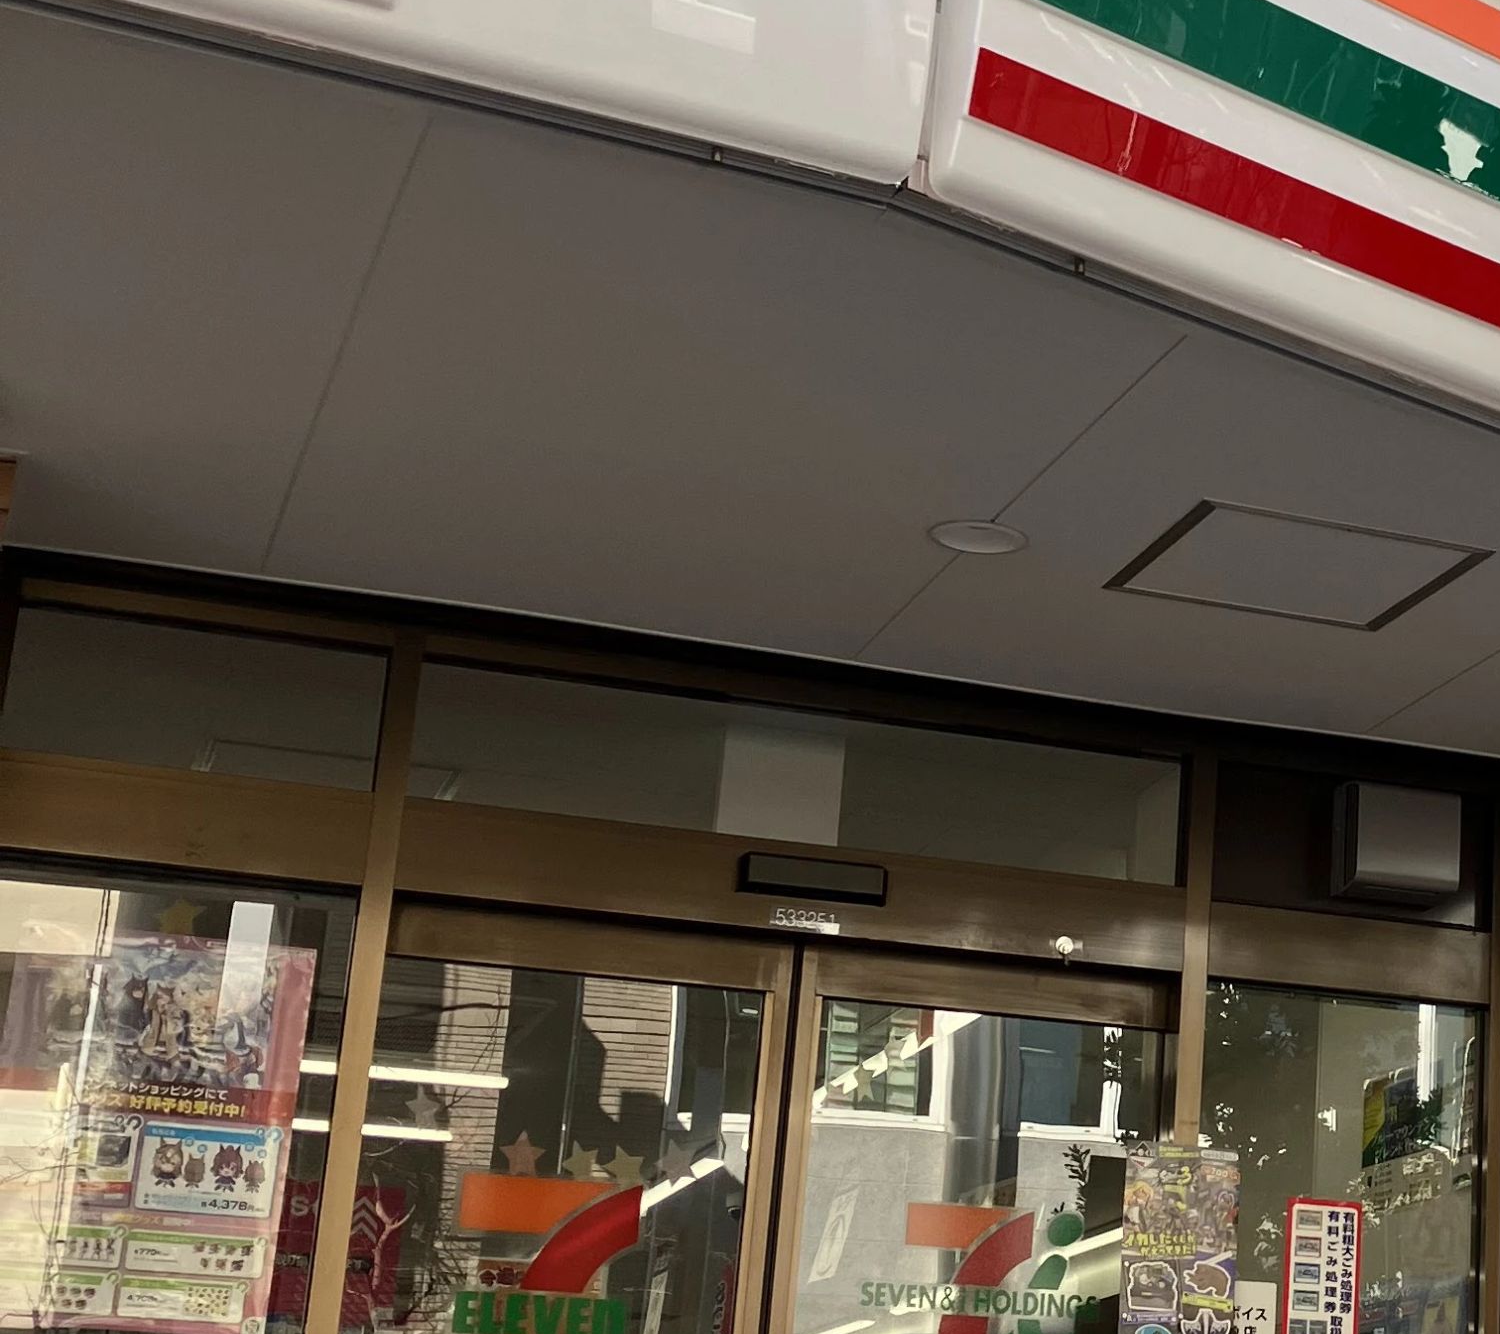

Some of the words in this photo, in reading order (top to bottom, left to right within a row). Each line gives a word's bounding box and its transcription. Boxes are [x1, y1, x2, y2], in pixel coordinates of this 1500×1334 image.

[1323, 1210, 1341, 1314] 有料ごみ処理券
[1340, 1211, 1356, 1315] 有料粗大ごみ処理券
